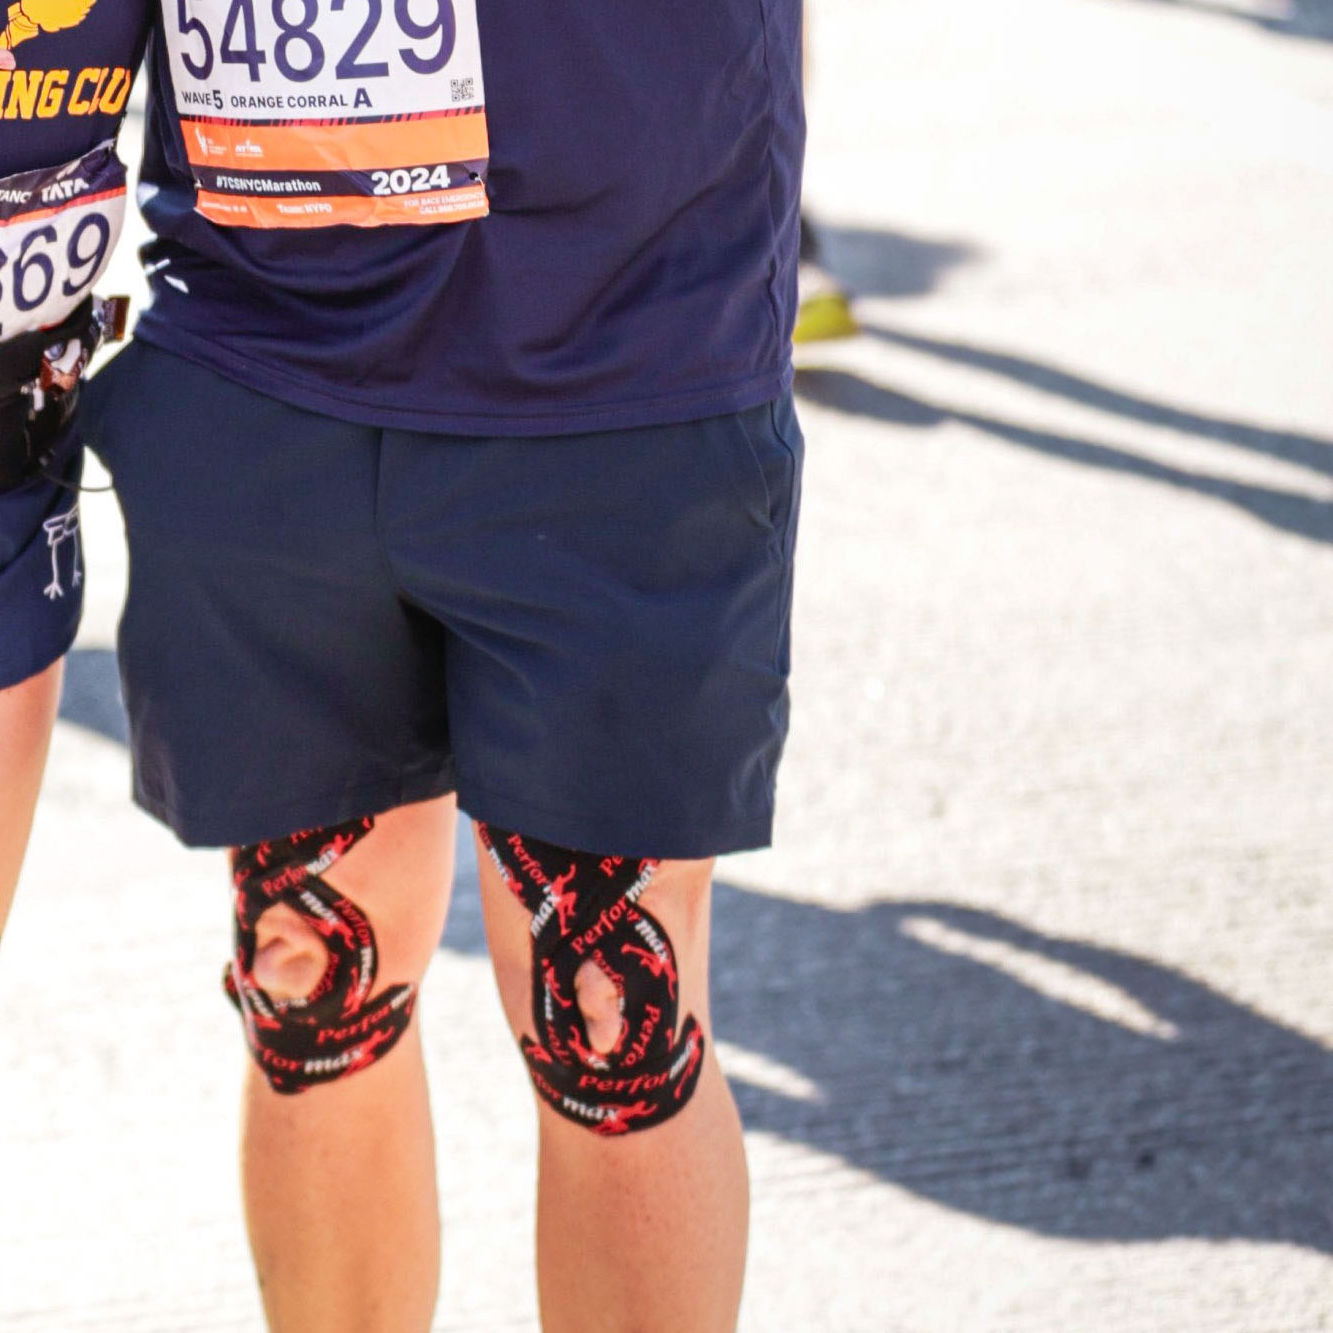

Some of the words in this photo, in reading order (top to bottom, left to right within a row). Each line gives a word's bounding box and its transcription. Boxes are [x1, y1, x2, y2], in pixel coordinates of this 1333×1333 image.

[181, 89, 213, 107] WAVE
[213, 88, 225, 111] 5
[230, 93, 285, 109] ORANGE
[287, 91, 348, 109] CORRAL
[353, 86, 374, 110] A
[215, 174, 323, 192] #TCSNYCMarathon
[371, 164, 452, 196] 2024
